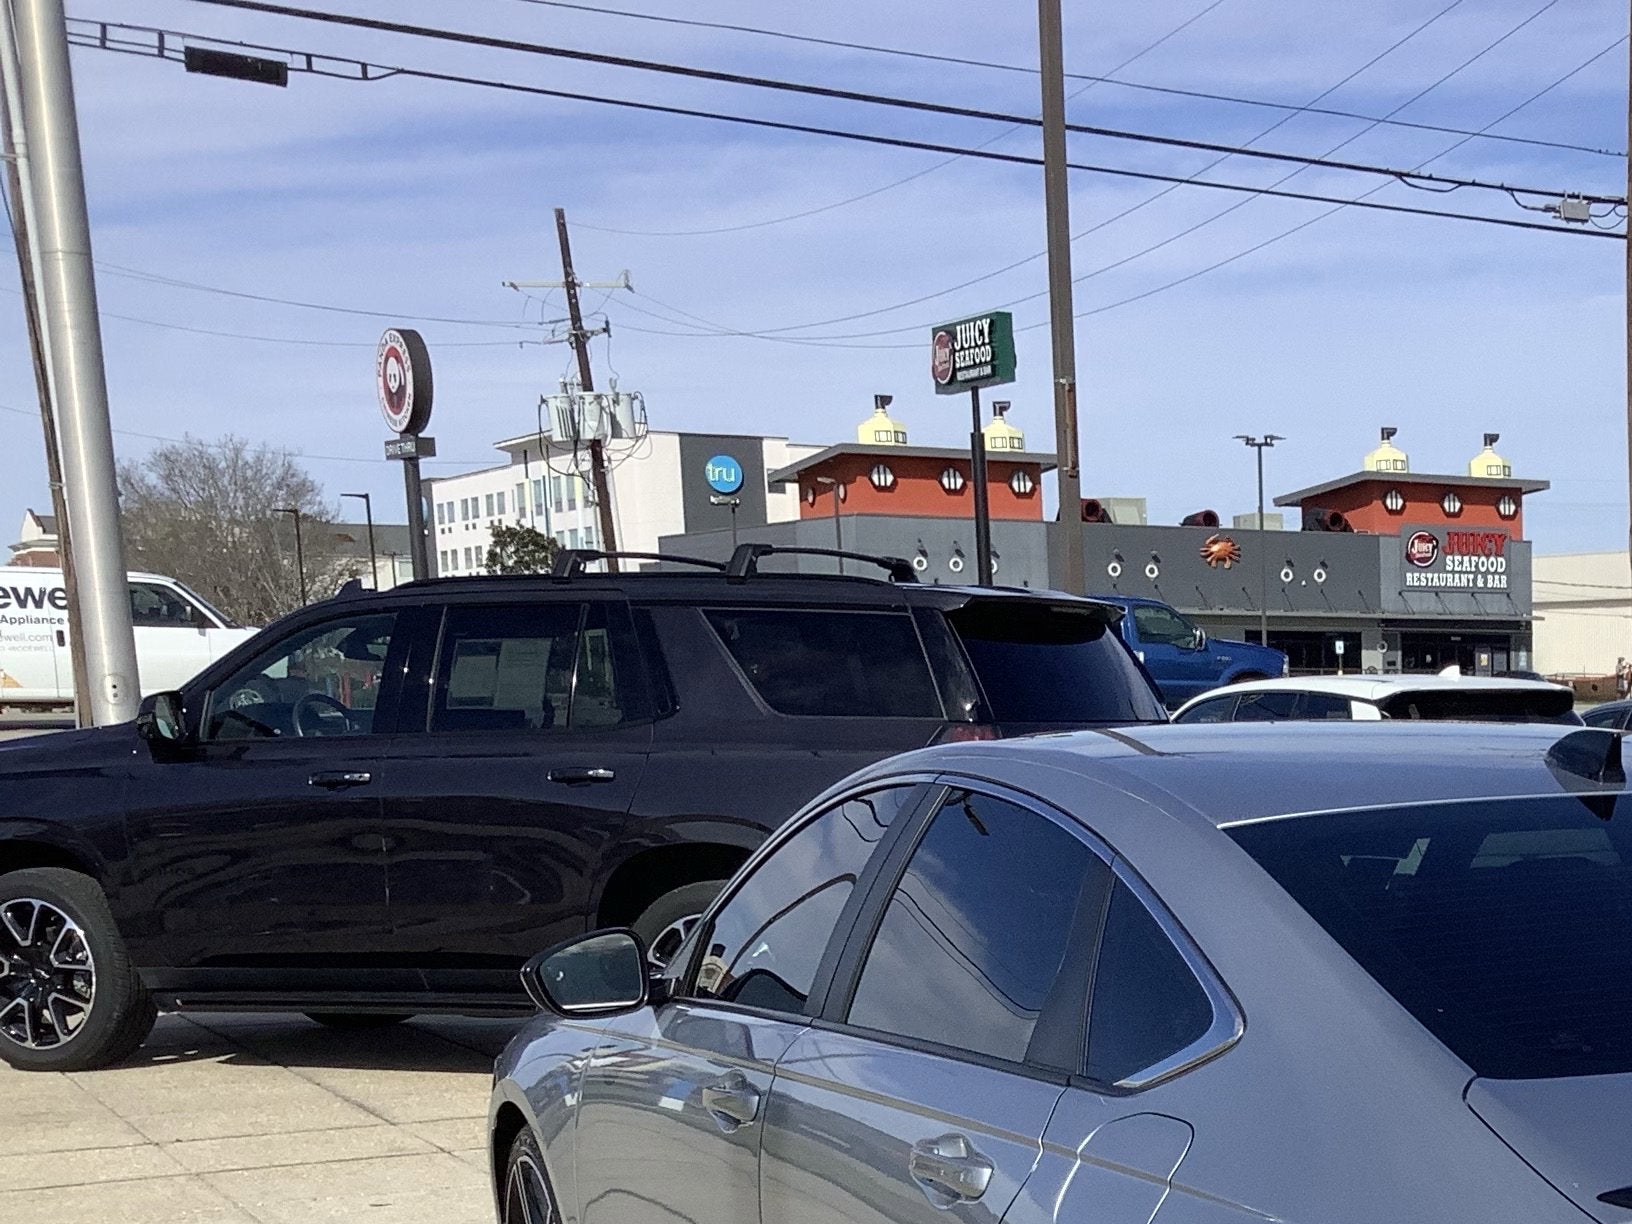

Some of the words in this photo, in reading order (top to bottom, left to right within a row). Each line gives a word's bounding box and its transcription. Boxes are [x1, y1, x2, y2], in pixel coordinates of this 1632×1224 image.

[954, 318, 990, 350] JUICY
[955, 345, 992, 368] SEAFOOD
[706, 462, 735, 483] tru
[1443, 532, 1507, 556] JUICY
[1446, 556, 1506, 573] SEAFOOD
[1406, 572, 1474, 587] RESTAURANT
[1476, 575, 1485, 587] &
[1487, 574, 1508, 588] BAR
[0, 614, 64, 625] Appliance
